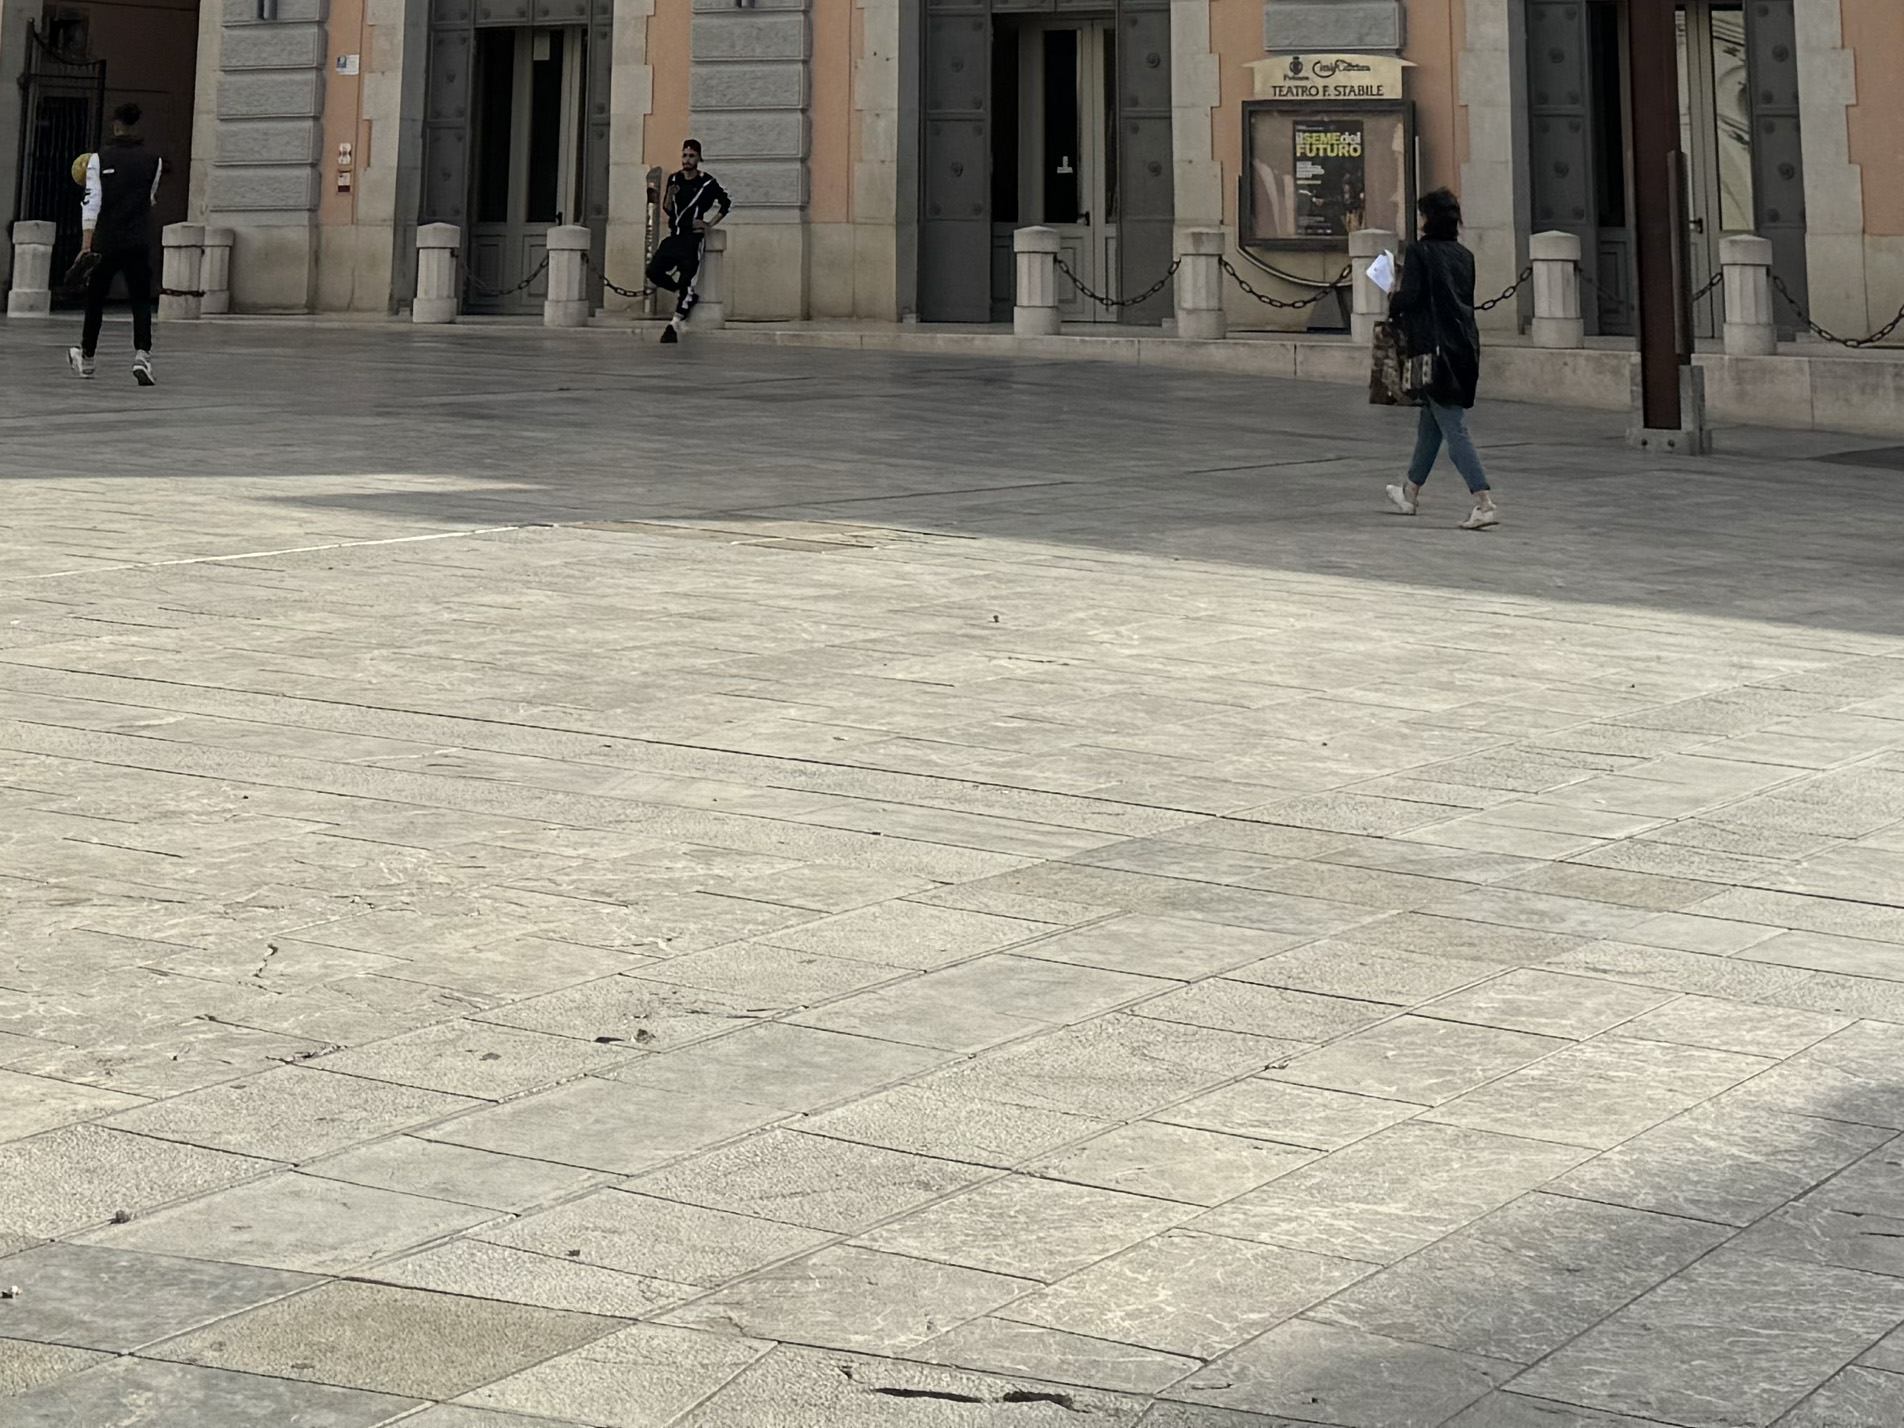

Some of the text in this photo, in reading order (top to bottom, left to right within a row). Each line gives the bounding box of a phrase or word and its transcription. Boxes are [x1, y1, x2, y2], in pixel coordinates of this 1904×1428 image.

[1272, 85, 1384, 97] TEATRO F. STABILE
[1296, 144, 1362, 157] FUTURO
